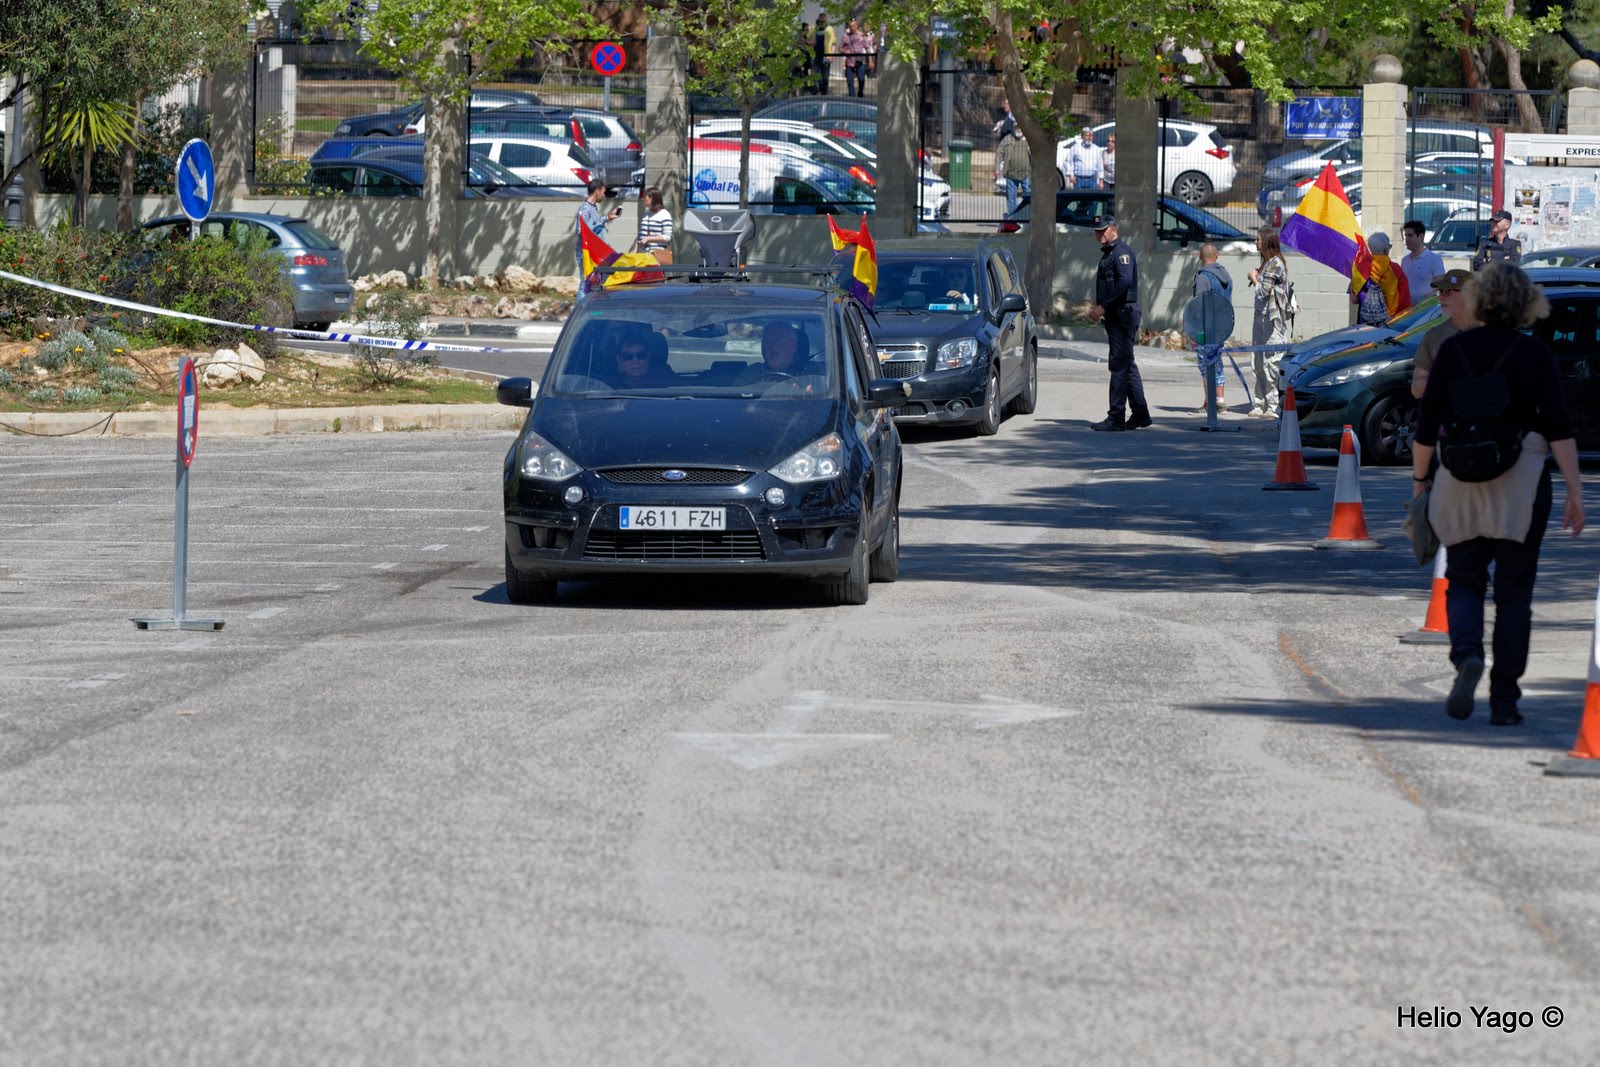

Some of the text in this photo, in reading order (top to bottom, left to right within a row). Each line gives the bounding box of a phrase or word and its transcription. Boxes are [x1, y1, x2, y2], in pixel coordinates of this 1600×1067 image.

[1337, 130, 1359, 138] PISCINA
[697, 181, 726, 192] Global
[635, 510, 722, 527] 4611 FZH
